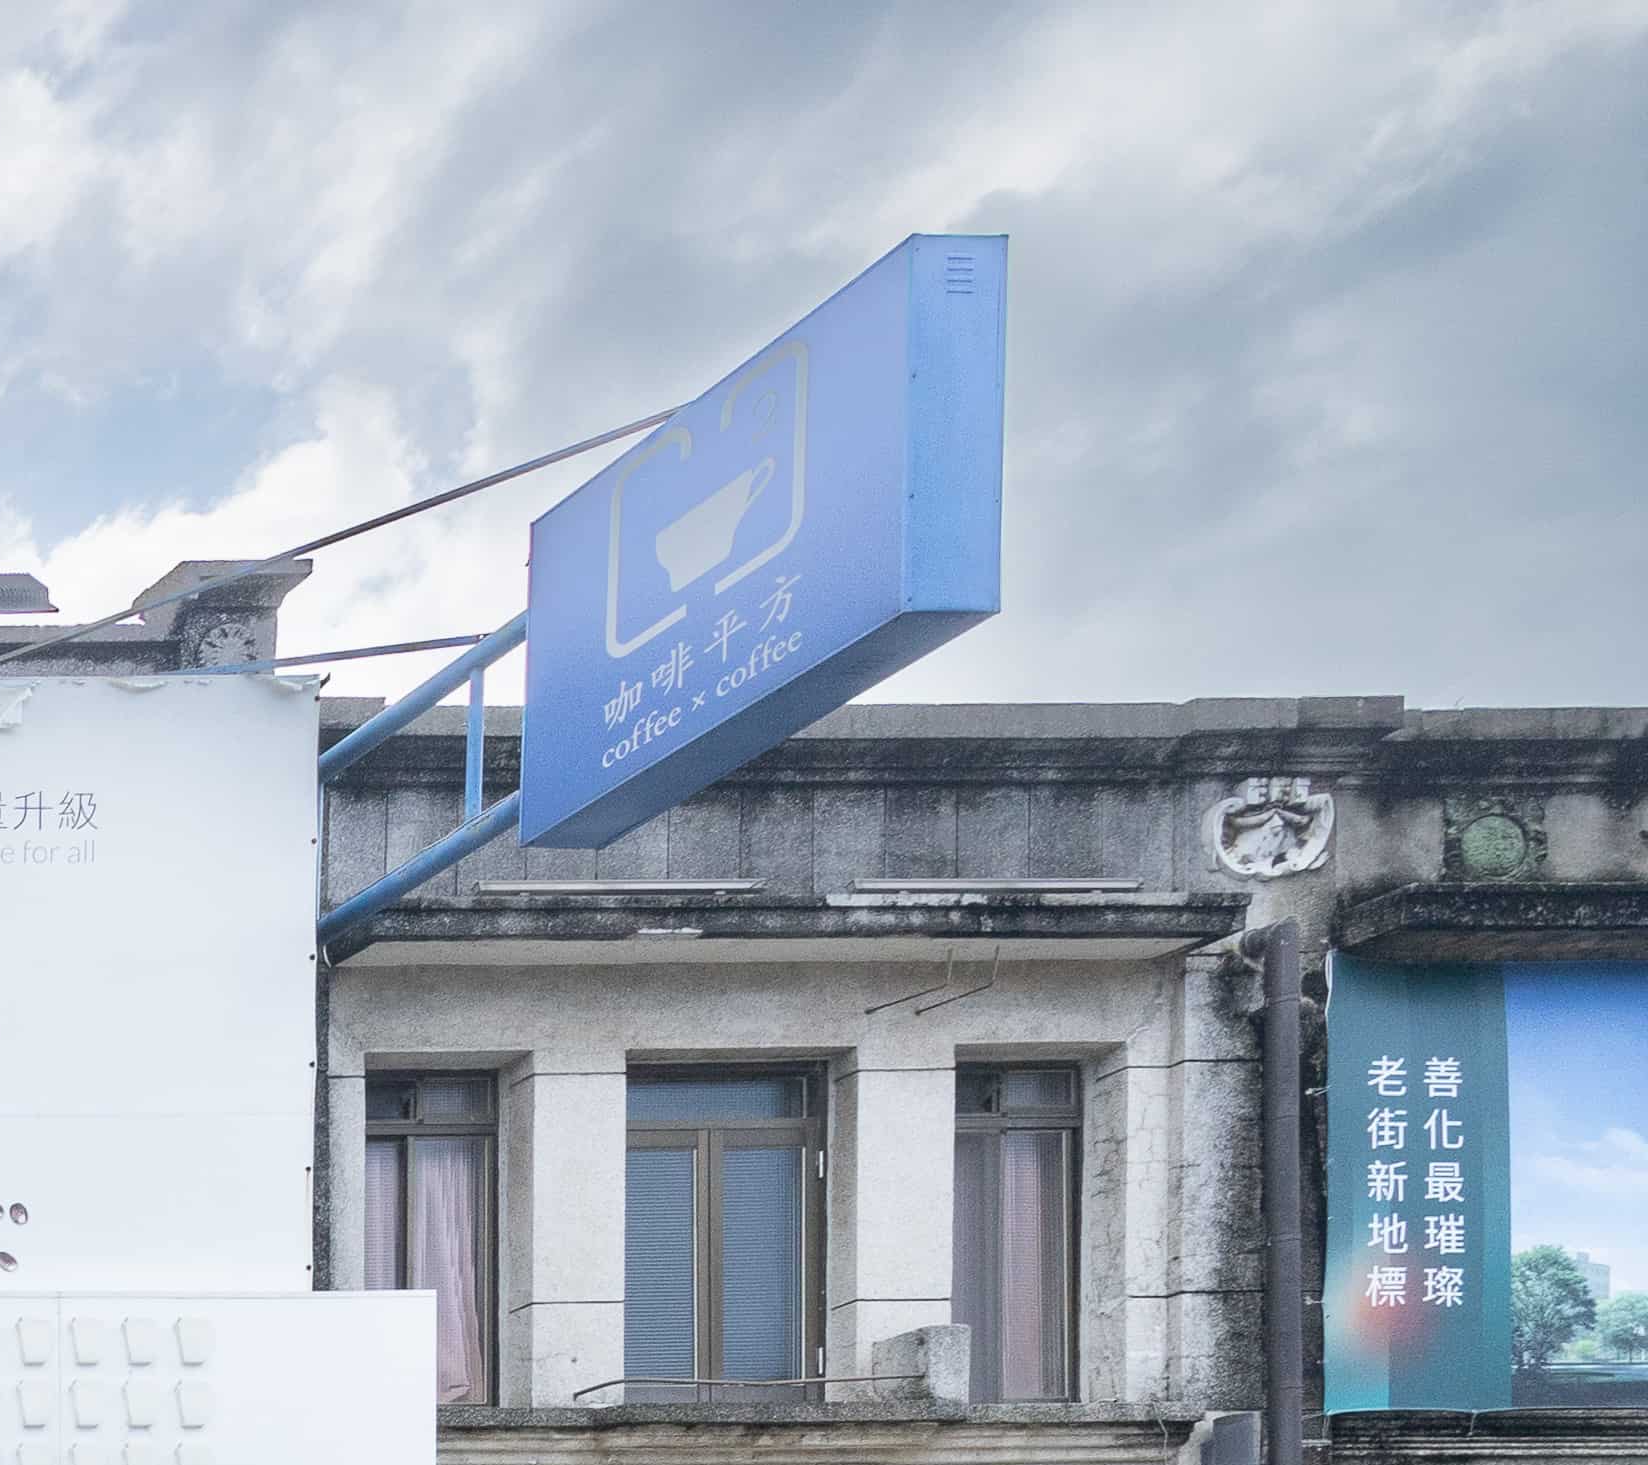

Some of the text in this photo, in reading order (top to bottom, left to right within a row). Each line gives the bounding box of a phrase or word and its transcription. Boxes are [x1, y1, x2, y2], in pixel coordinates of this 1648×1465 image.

[601, 705, 681, 769] coffee
[715, 628, 803, 700] coffee
[602, 573, 803, 733] 咖啡平方
[21, 838, 60, 866] for
[66, 838, 97, 866] all
[1365, 1054, 1410, 1309] 老街新地標
[1421, 1056, 1467, 1309] 善化最璀璨
